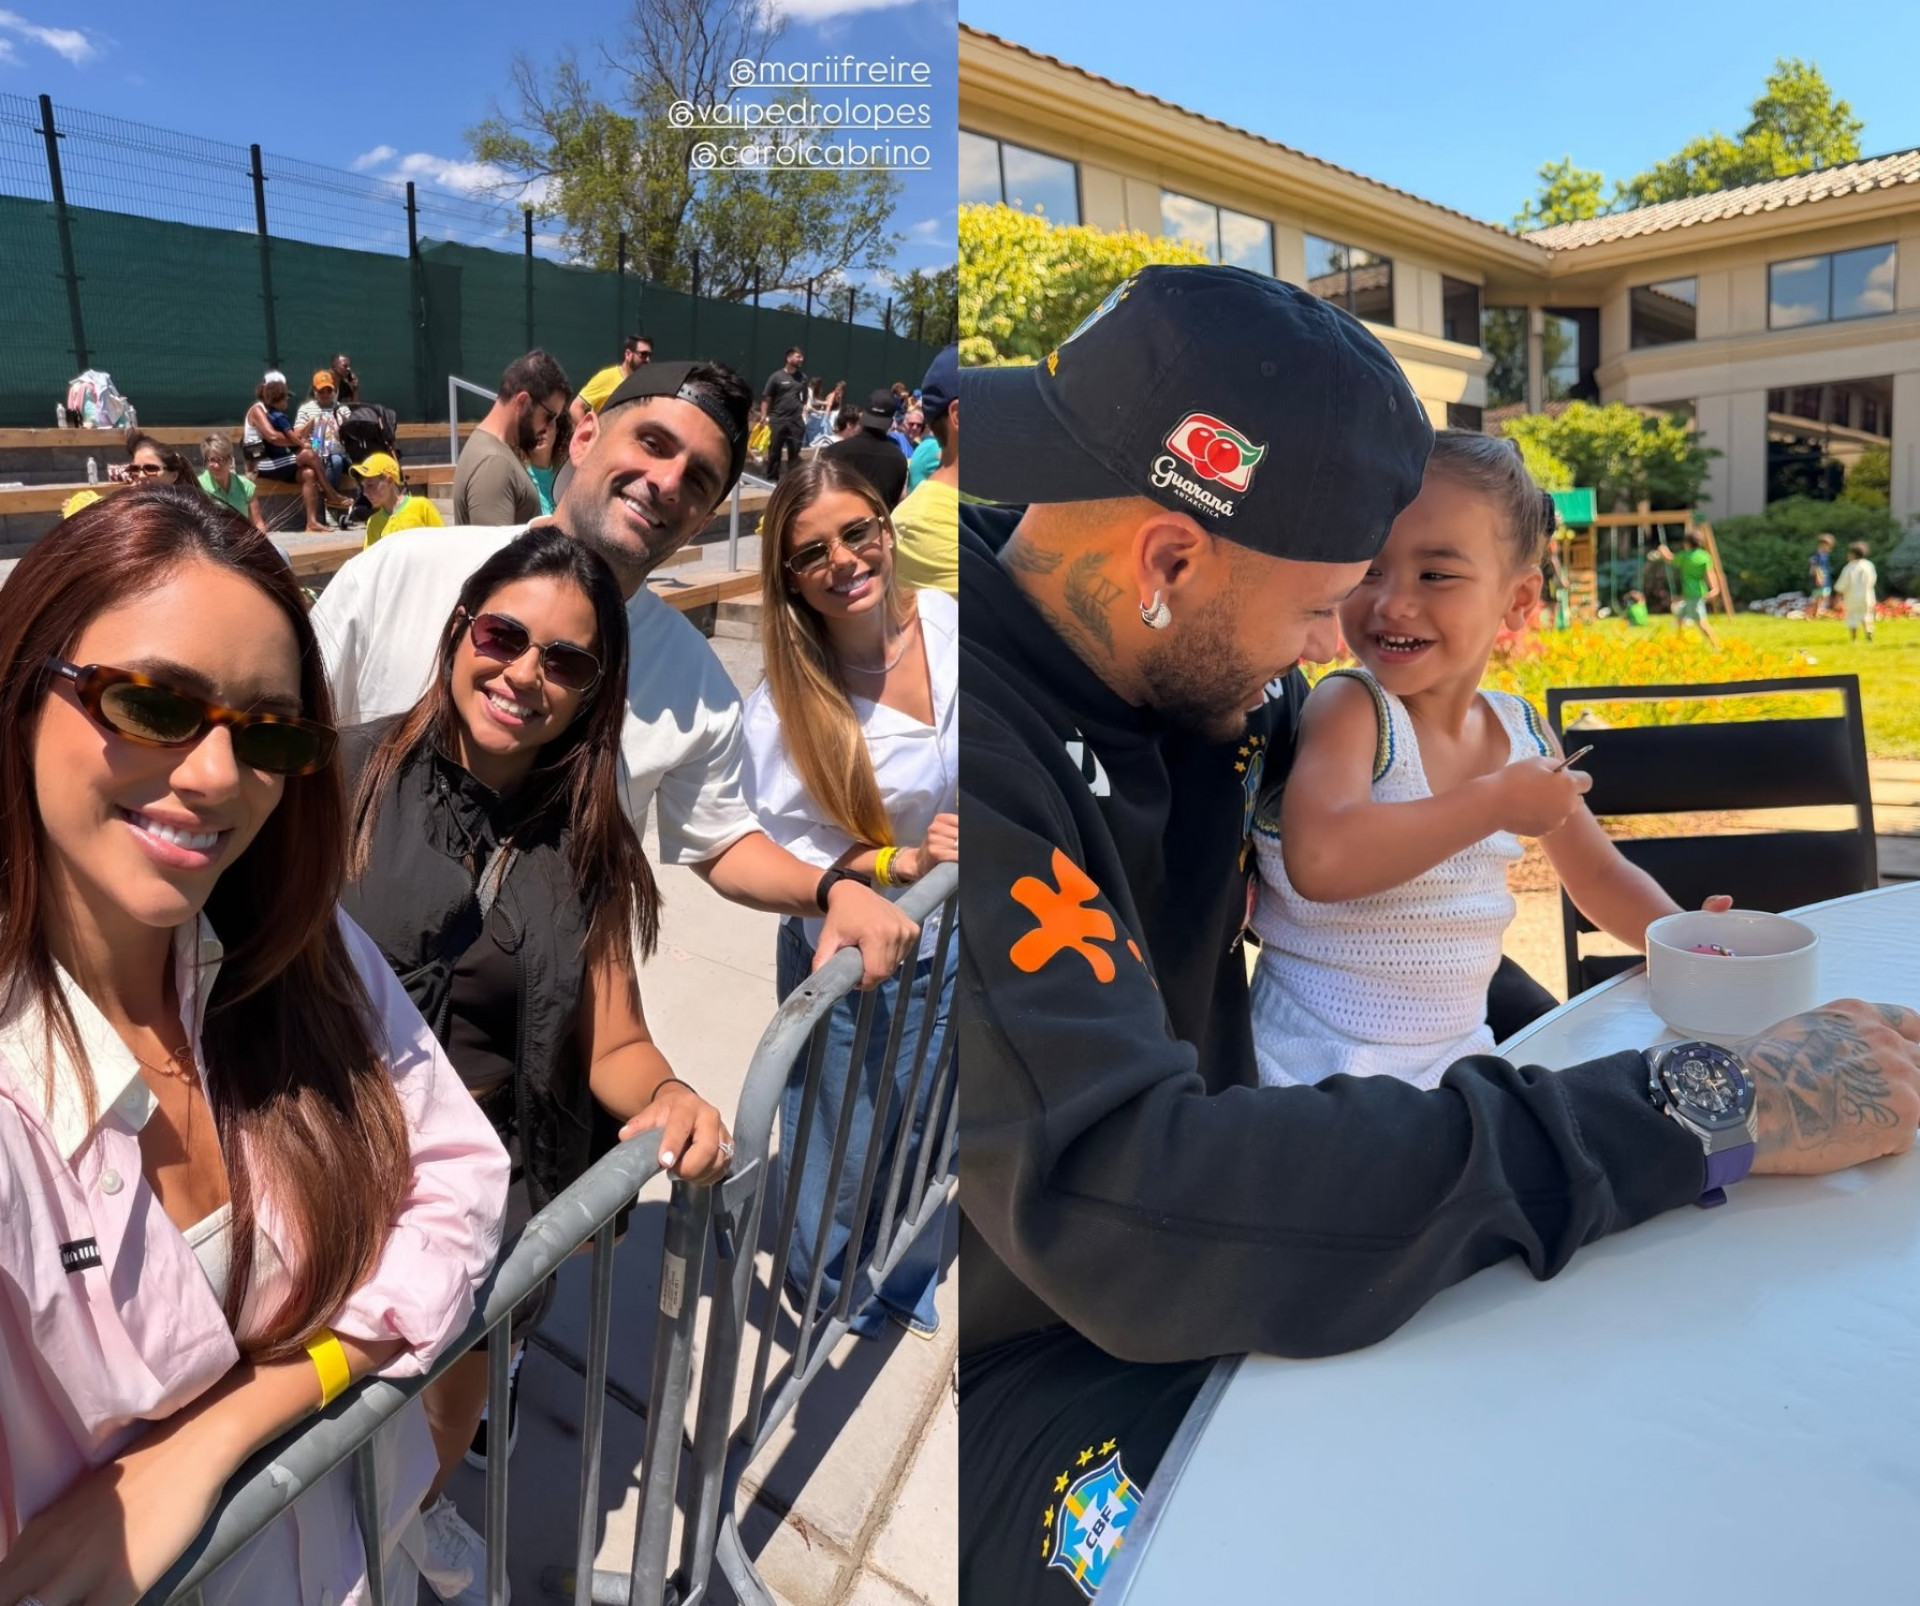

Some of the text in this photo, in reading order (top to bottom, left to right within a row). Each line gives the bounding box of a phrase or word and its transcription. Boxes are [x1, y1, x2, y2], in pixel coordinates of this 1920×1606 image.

[1151, 455, 1234, 517] Guaraná
[1174, 489, 1219, 519] ANTARCTICA
[1085, 1504, 1112, 1549] CBF
